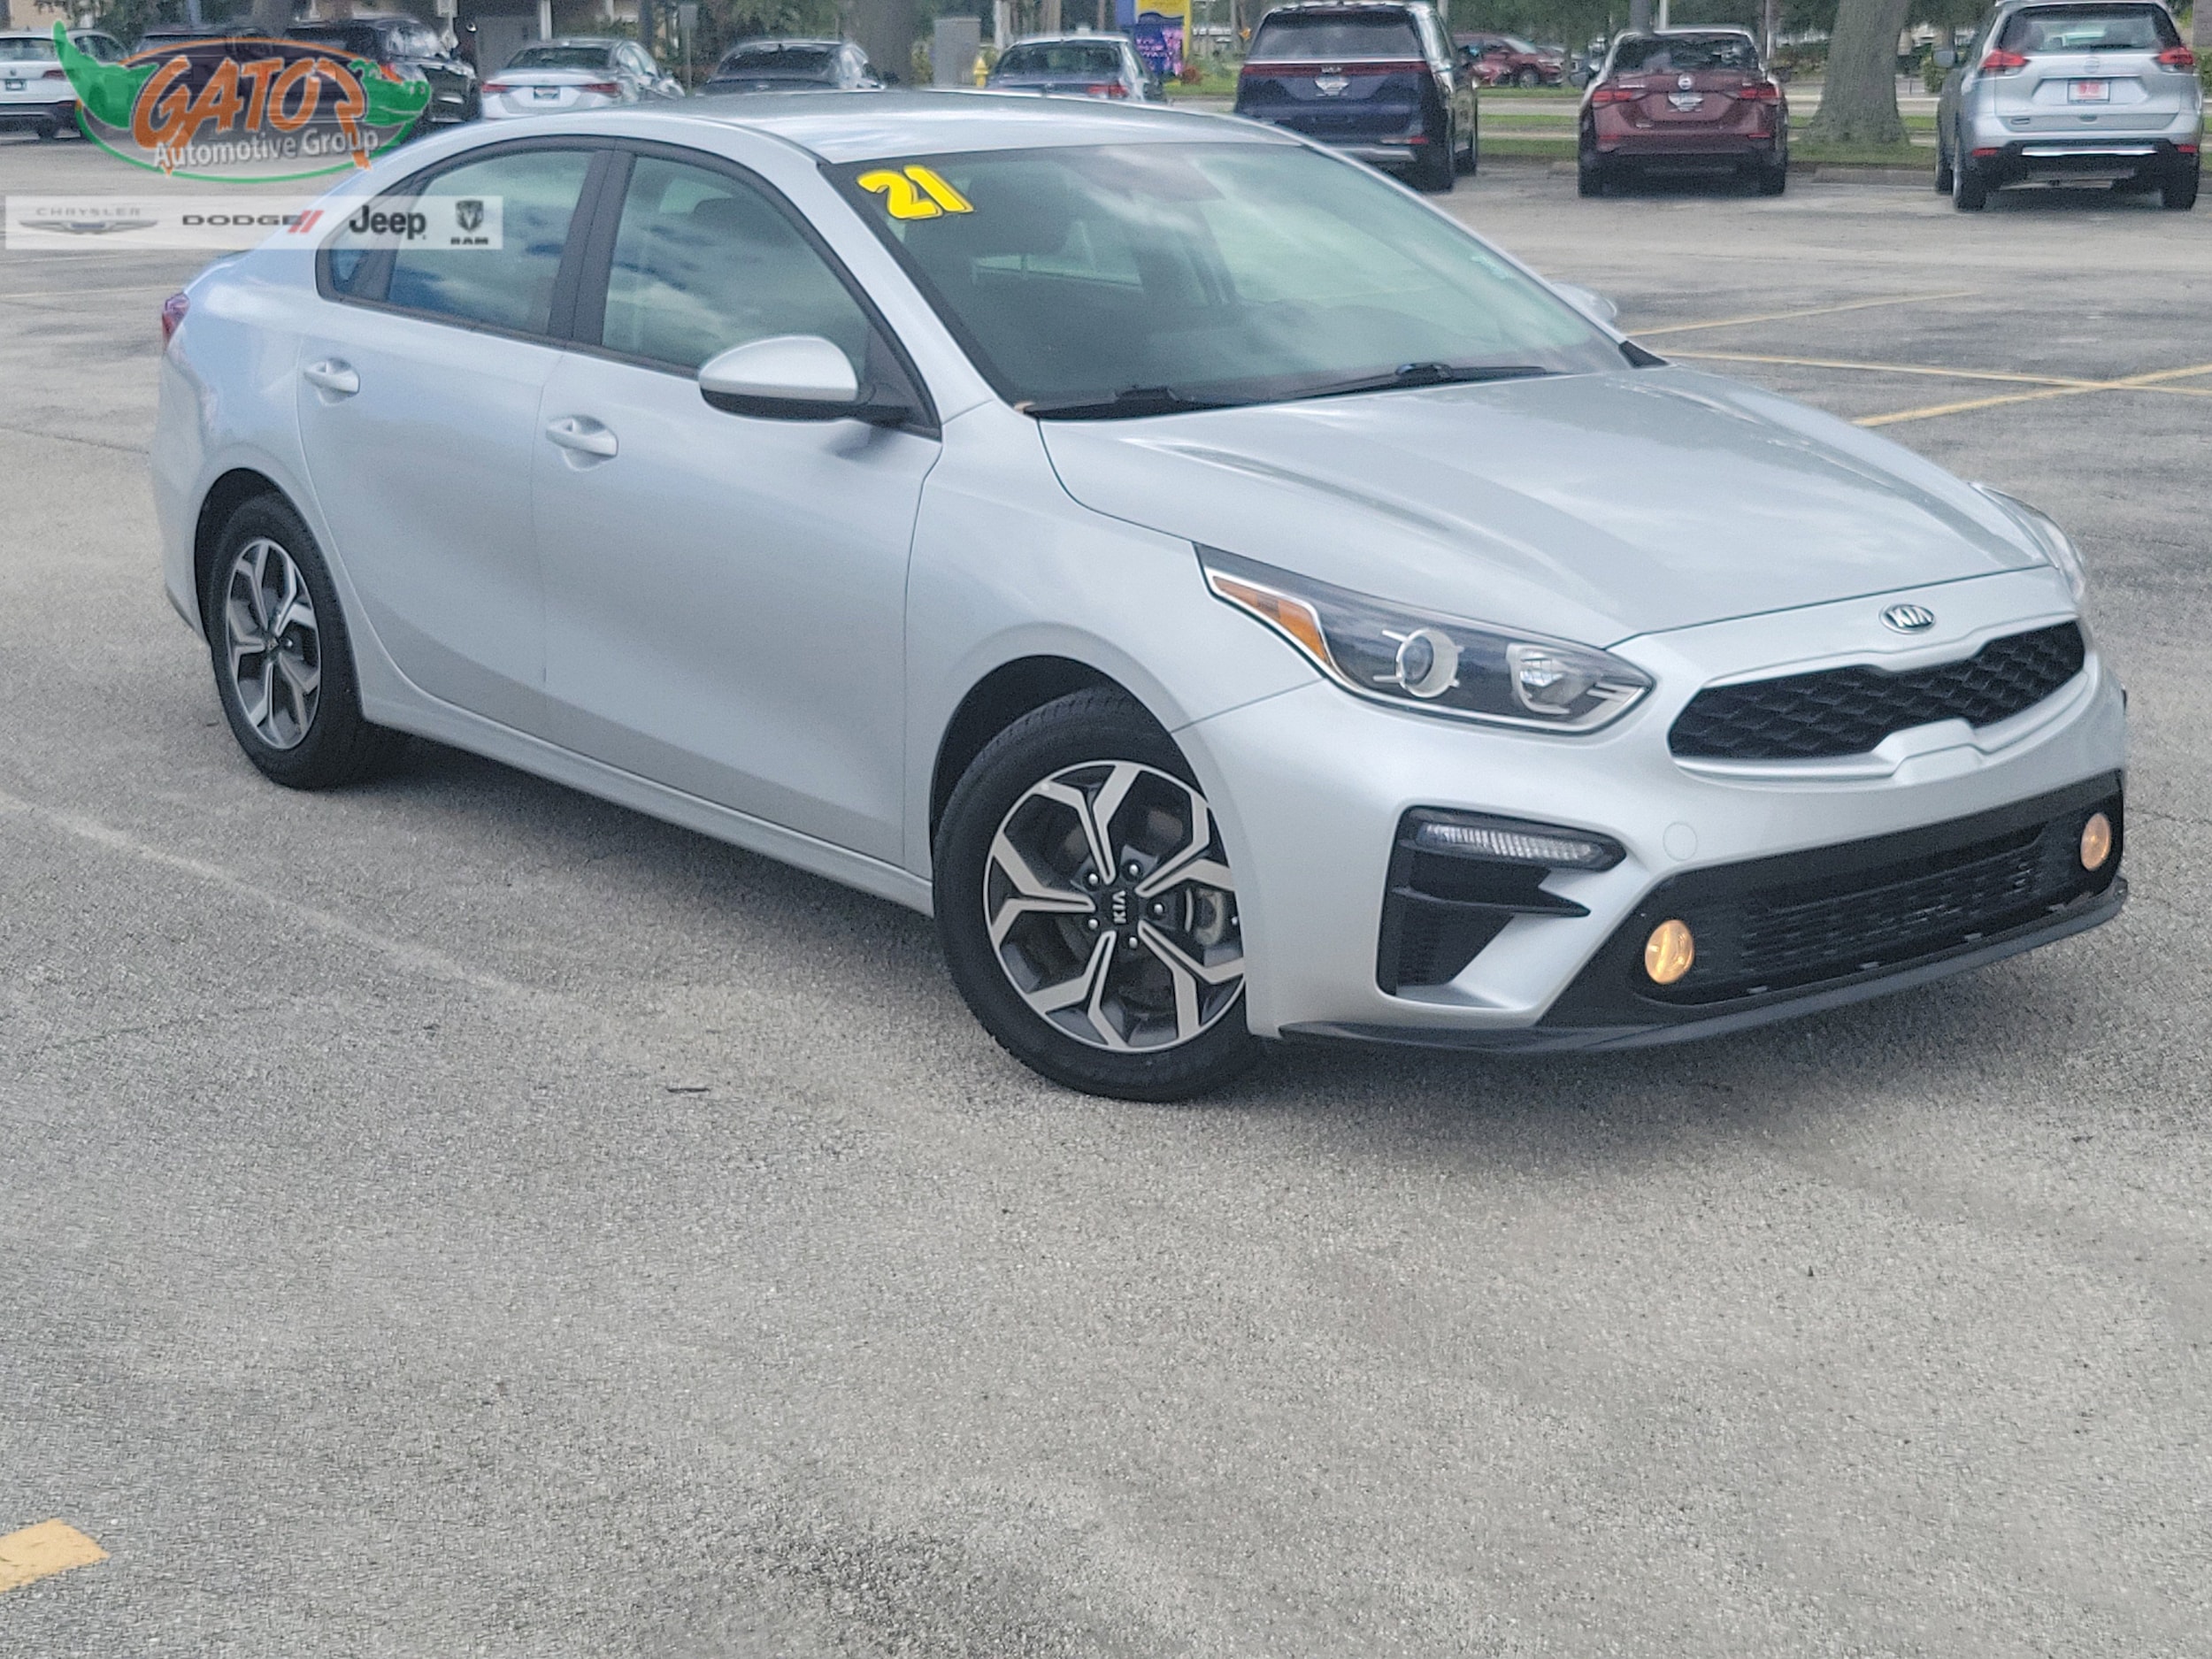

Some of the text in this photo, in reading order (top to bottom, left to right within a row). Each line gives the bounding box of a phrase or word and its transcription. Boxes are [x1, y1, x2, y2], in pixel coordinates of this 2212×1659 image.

[856, 165, 974, 220] 21
[1886, 605, 1932, 628] KIA
[1112, 890, 1127, 925] KIA
